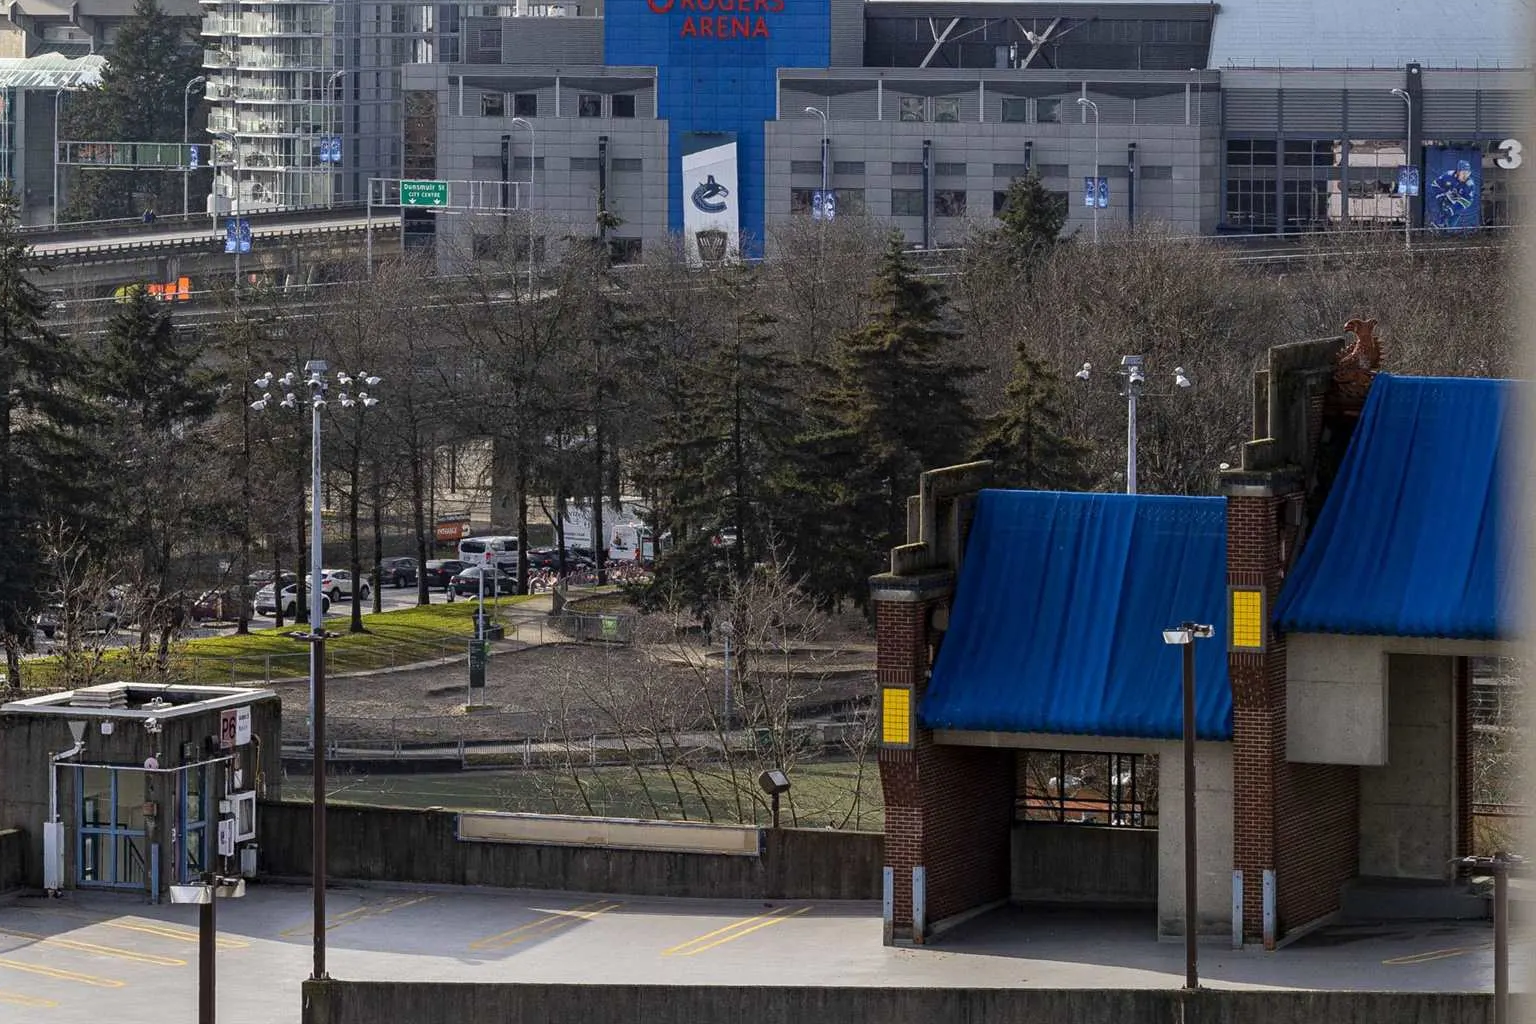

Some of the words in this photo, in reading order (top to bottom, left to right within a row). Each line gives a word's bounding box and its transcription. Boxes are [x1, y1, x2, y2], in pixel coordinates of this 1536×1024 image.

[680, 15, 770, 38] ARENA
[1496, 139, 1522, 169] 3
[404, 183, 435, 191] Dunsmuir
[222, 717, 236, 740] P6
